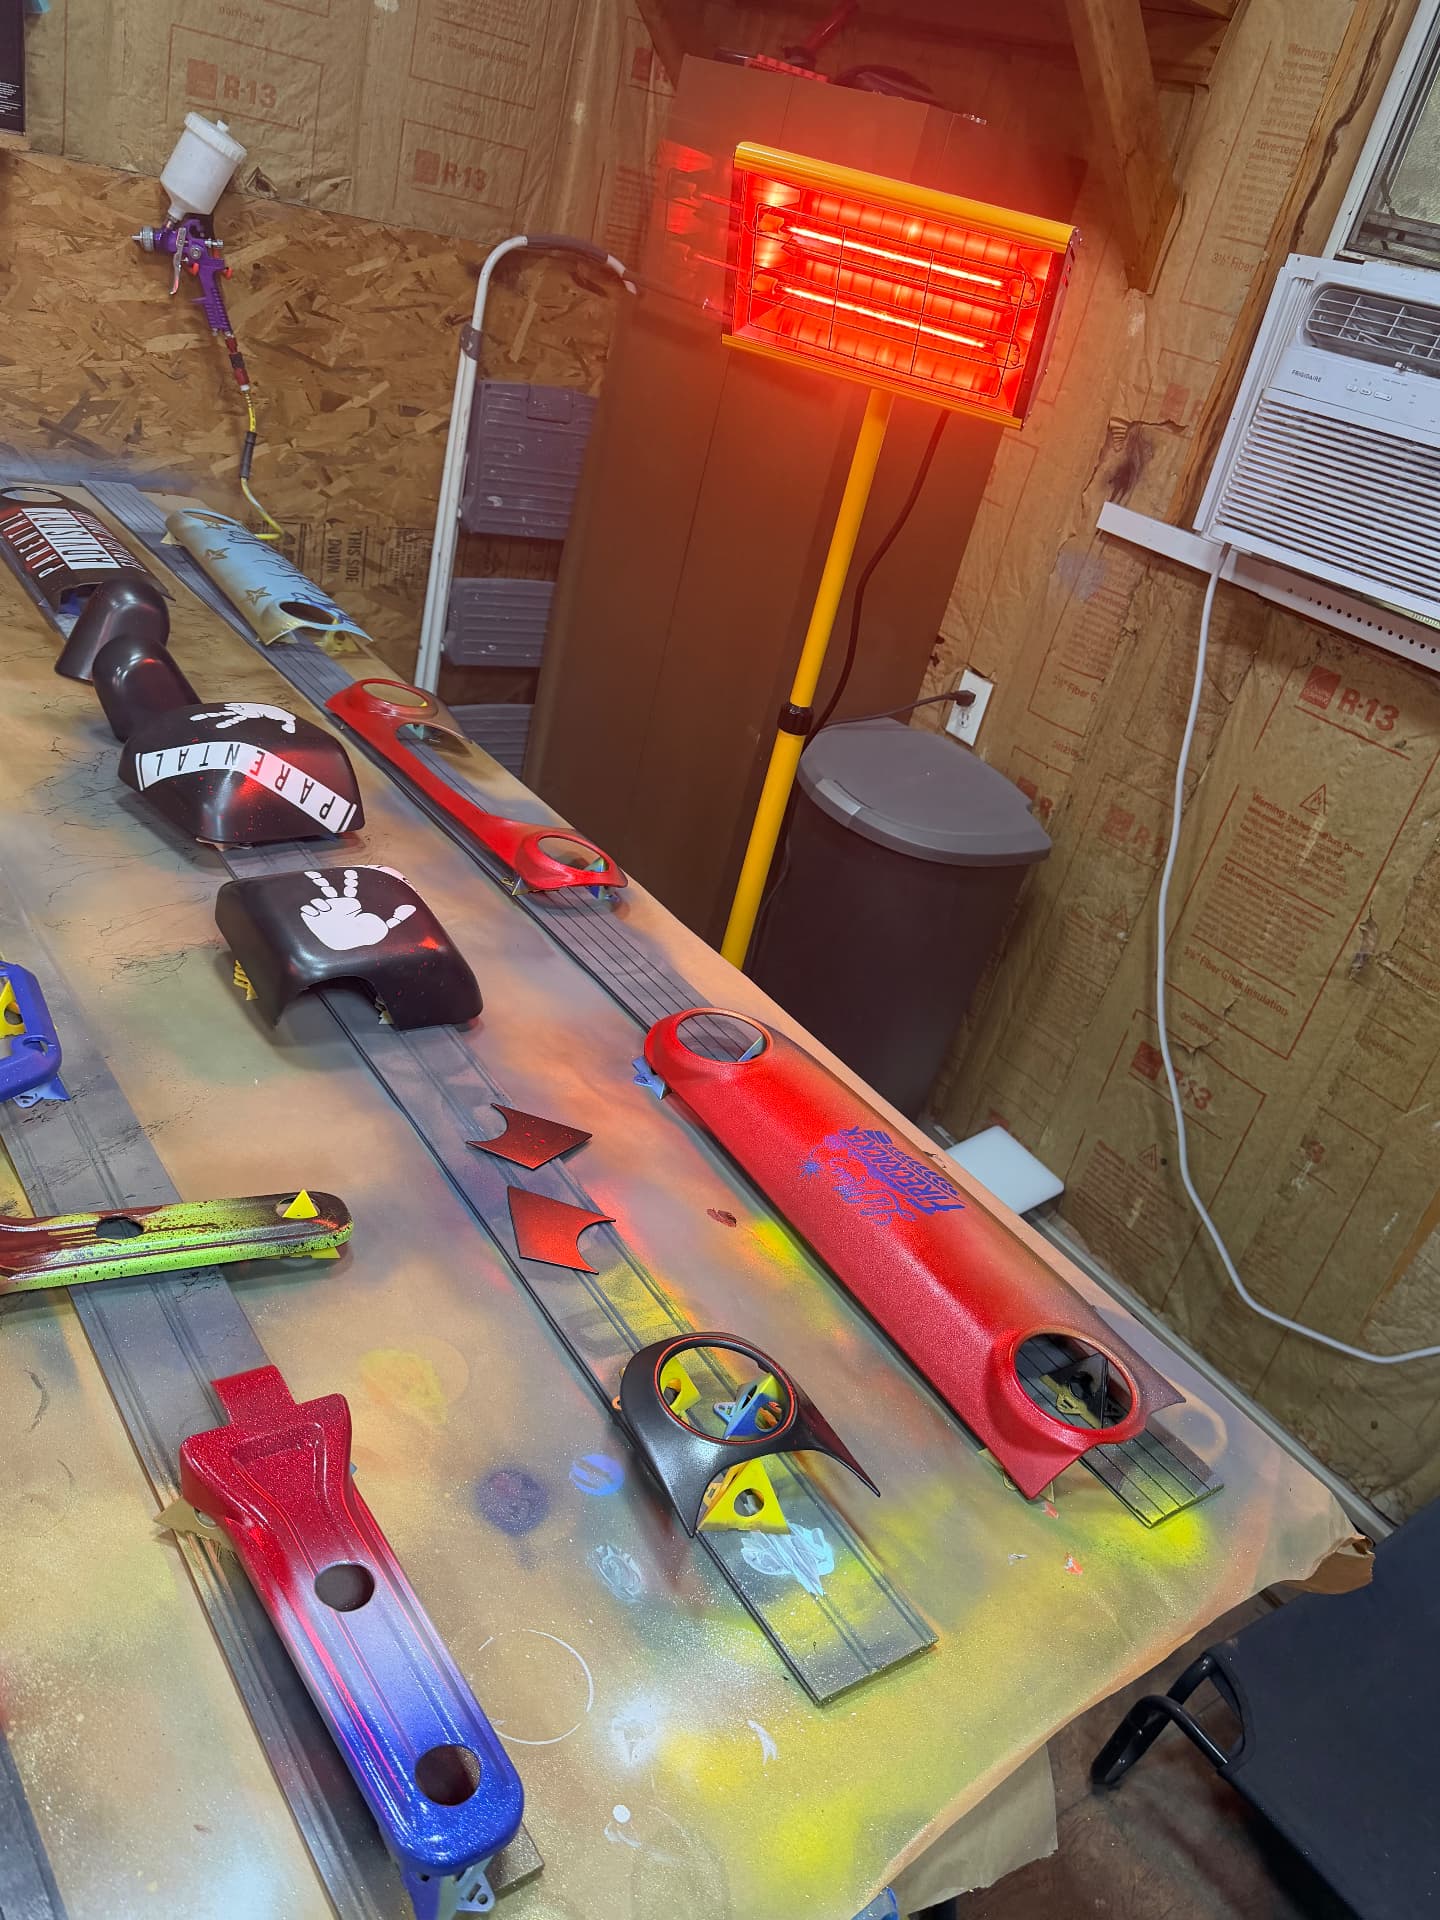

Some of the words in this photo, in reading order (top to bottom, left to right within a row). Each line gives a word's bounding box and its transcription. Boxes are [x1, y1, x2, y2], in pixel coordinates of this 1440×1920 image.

[223, 74, 278, 109] R-13
[443, 160, 488, 192] R-13
[1291, 369, 1323, 383] FRIGIDAIRE
[0, 512, 65, 579] PARENTAL
[26, 511, 115, 564] ADVISORY
[348, 527, 362, 555] THIS
[327, 538, 342, 574] DOWN
[345, 559, 361, 584] SIDE
[1337, 687, 1400, 732] R-13
[155, 743, 336, 821] PARENTAL
[838, 1125, 966, 1215] FIRECRACKER
